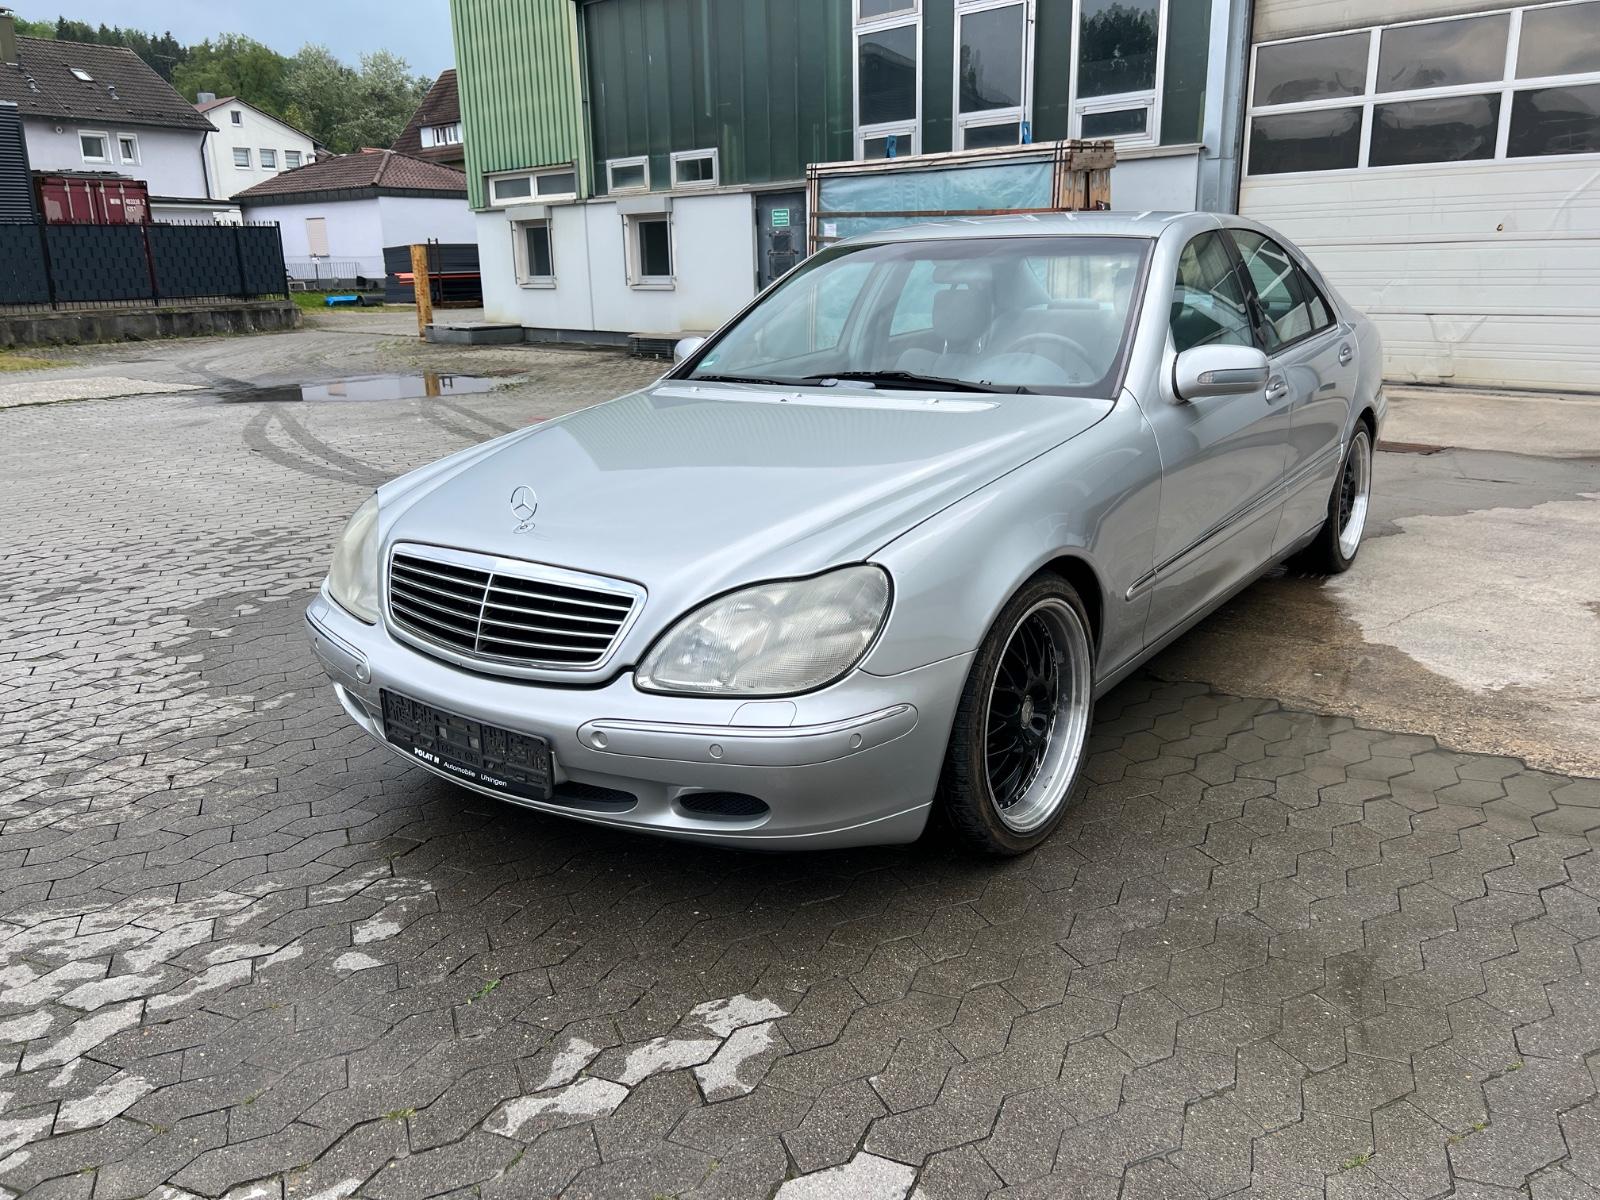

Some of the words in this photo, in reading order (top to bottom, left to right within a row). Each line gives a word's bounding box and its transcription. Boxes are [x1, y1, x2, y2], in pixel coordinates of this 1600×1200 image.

[414, 747, 434, 761] POLAT
[443, 761, 476, 778] Automobile
[480, 773, 507, 787] Uhingen
